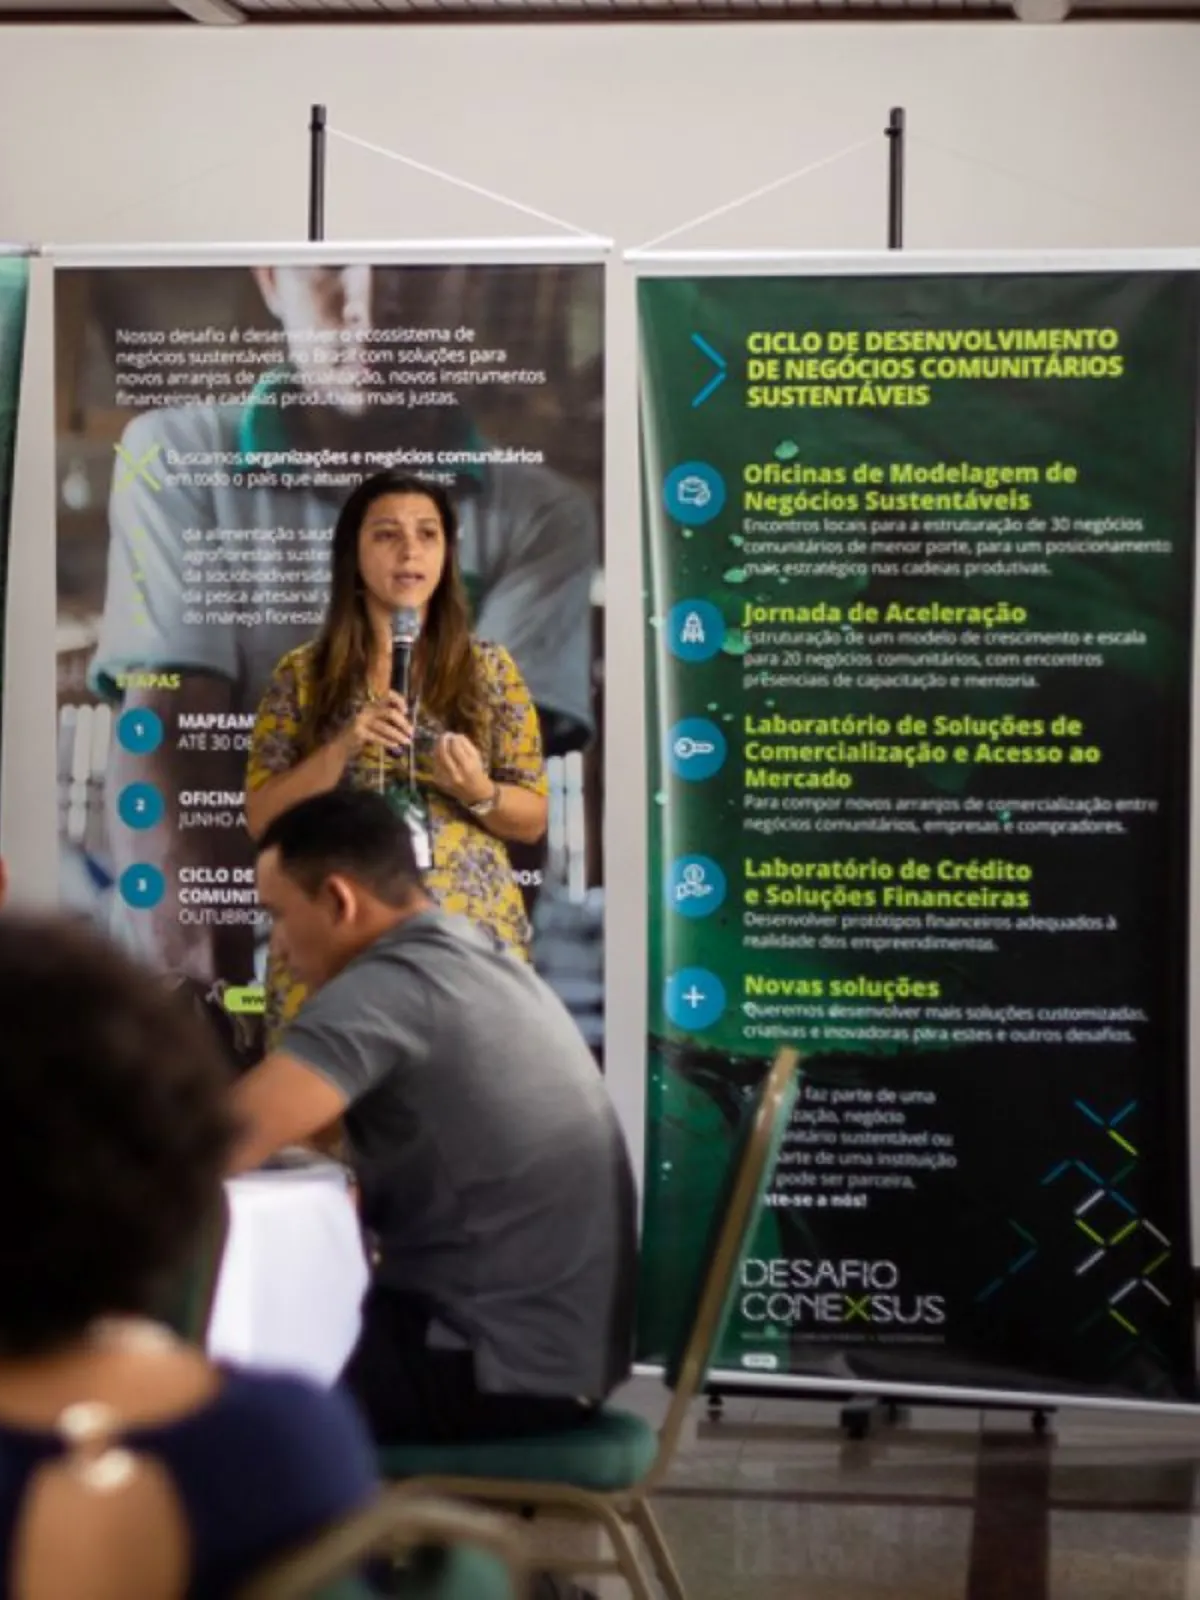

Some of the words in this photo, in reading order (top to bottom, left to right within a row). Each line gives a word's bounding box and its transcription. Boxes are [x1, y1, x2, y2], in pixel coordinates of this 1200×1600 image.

[116, 329, 164, 343] Nosso
[169, 326, 224, 343] desafio
[356, 327, 449, 342] ecossistema
[746, 331, 822, 354] CICLO
[827, 331, 860, 351] DE
[865, 328, 1119, 351] DESENVOLVIMENTO
[116, 350, 185, 368] negócios
[189, 348, 284, 363] sustentáveis
[360, 352, 392, 362] com
[399, 348, 465, 365] soluções
[469, 350, 507, 365] para
[747, 358, 780, 381] DE
[785, 352, 915, 379] NEGÓCIOS
[921, 349, 1125, 379] COMUNITÁRIOS
[116, 373, 163, 384] novos
[167, 372, 230, 387] arranjos
[389, 372, 436, 383] novos
[440, 369, 546, 383] instrumentos
[367, 392, 404, 404] mais
[408, 391, 458, 408] justas.
[746, 380, 931, 407] SUSTENTÁVEIS
[246, 450, 347, 467] organizações
[365, 450, 434, 467] negócios
[438, 449, 543, 463] comunitários
[248, 473, 278, 488] país
[314, 474, 361, 485] atuam
[743, 463, 847, 485] Oficinas
[852, 462, 885, 483] de
[889, 461, 1040, 486] Modelagem
[1045, 461, 1078, 484] de
[743, 491, 859, 517] Negócios
[865, 491, 1032, 511] Sustentáveis
[206, 527, 294, 543] alimentação
[742, 517, 820, 533] Encontros
[823, 519, 867, 532] locais
[870, 521, 907, 535] para
[923, 517, 1023, 536] estruturação
[1026, 517, 1047, 532] de
[1051, 517, 1071, 532] 30
[1072, 516, 1144, 535] negócios
[742, 537, 844, 554] comunitários
[847, 539, 867, 554] de
[871, 541, 922, 553] menor
[925, 540, 972, 557] porte,
[976, 541, 1012, 557] para
[1016, 541, 1042, 553] um
[1045, 539, 1172, 556] posicionamento
[743, 563, 780, 576] mais
[782, 561, 869, 579] estratégico
[871, 563, 900, 576] nas
[901, 560, 961, 576] cadeias
[963, 560, 1052, 578] produtivas.
[253, 590, 317, 601] artesanal
[206, 613, 261, 627] manejo
[742, 602, 842, 627] Jornada
[847, 601, 879, 623] de
[885, 601, 1028, 628] Aceleração
[742, 631, 841, 650] Estruturação
[845, 631, 864, 645] de
[868, 632, 894, 645] um
[897, 631, 957, 645] modelo
[960, 631, 981, 645] de
[986, 631, 1081, 646] crescimento
[1097, 630, 1147, 645] escala
[743, 654, 779, 669] para
[782, 650, 802, 666] 20
[805, 652, 873, 669] negócios
[877, 652, 982, 668] comunitários,
[985, 654, 1020, 667] com
[1023, 653, 1104, 667] encontros
[742, 671, 831, 690] presenciais
[832, 673, 854, 688] de
[855, 673, 948, 691] capacitação
[963, 674, 1040, 688] mentoria.
[178, 714, 255, 728] MAPEAM
[744, 713, 891, 735] Laboratório
[896, 714, 928, 735] de
[933, 714, 1045, 740] Soluções
[1050, 715, 1083, 736] de
[177, 733, 206, 749] ATÉ
[744, 741, 948, 767] Comercialização
[952, 747, 969, 763] e
[973, 743, 1064, 764] Acesso
[1068, 746, 1101, 763] ao
[744, 767, 853, 790] Mercado
[743, 793, 778, 810] Para
[781, 797, 841, 814] compor
[845, 797, 893, 811] novos
[895, 798, 961, 814] arranjos
[963, 796, 984, 811] de
[987, 796, 1114, 813] comercialização
[1115, 798, 1159, 812] entre
[179, 813, 232, 829] JUNHO
[743, 817, 812, 835] negócios
[814, 817, 921, 834] comunitários,
[922, 820, 1001, 835] empresas
[1016, 819, 1126, 837] compradores.
[179, 868, 228, 882] CICLO
[744, 857, 894, 880] Laboratório
[899, 858, 932, 879] de
[936, 859, 1033, 882] Crédito
[179, 890, 258, 903] COMUNIT
[743, 888, 759, 905] e
[766, 885, 877, 911] Soluções
[883, 887, 1031, 909] Financeiras
[742, 910, 837, 927] Desenvolver
[841, 915, 922, 931] protótipos
[926, 915, 1014, 931] financeiros
[1015, 915, 1105, 933] adequados
[742, 933, 816, 949] realidade
[818, 934, 848, 949] dos
[849, 936, 998, 953] empreendimentos.
[744, 974, 824, 997] Novas
[829, 975, 941, 1002] soluções
[742, 1002, 825, 1019] Queremos
[827, 1004, 921, 1019] desenvolver
[925, 1006, 963, 1020] mais
[964, 1005, 1035, 1023] soluções
[1036, 1005, 1148, 1022] customizadas,
[742, 1025, 807, 1039] criativas
[823, 1026, 910, 1042] inovadoras
[912, 1027, 950, 1044] para
[952, 1028, 993, 1042] estes
[1010, 1029, 1063, 1043] outros
[1064, 1027, 1136, 1043] desafios.
[806, 1088, 828, 1100] faz
[831, 1090, 872, 1104] parte
[900, 1092, 935, 1103] uma
[844, 1110, 905, 1126] negócio
[841, 1131, 927, 1145] sustentável
[840, 1154, 872, 1165] uma
[877, 1153, 956, 1168] instituição
[821, 1174, 842, 1185] ser
[849, 1175, 916, 1188] parceira,
[831, 1194, 866, 1206] nós!
[741, 1259, 898, 1289] DESAFIO
[740, 1292, 945, 1323] CONEXSUS
